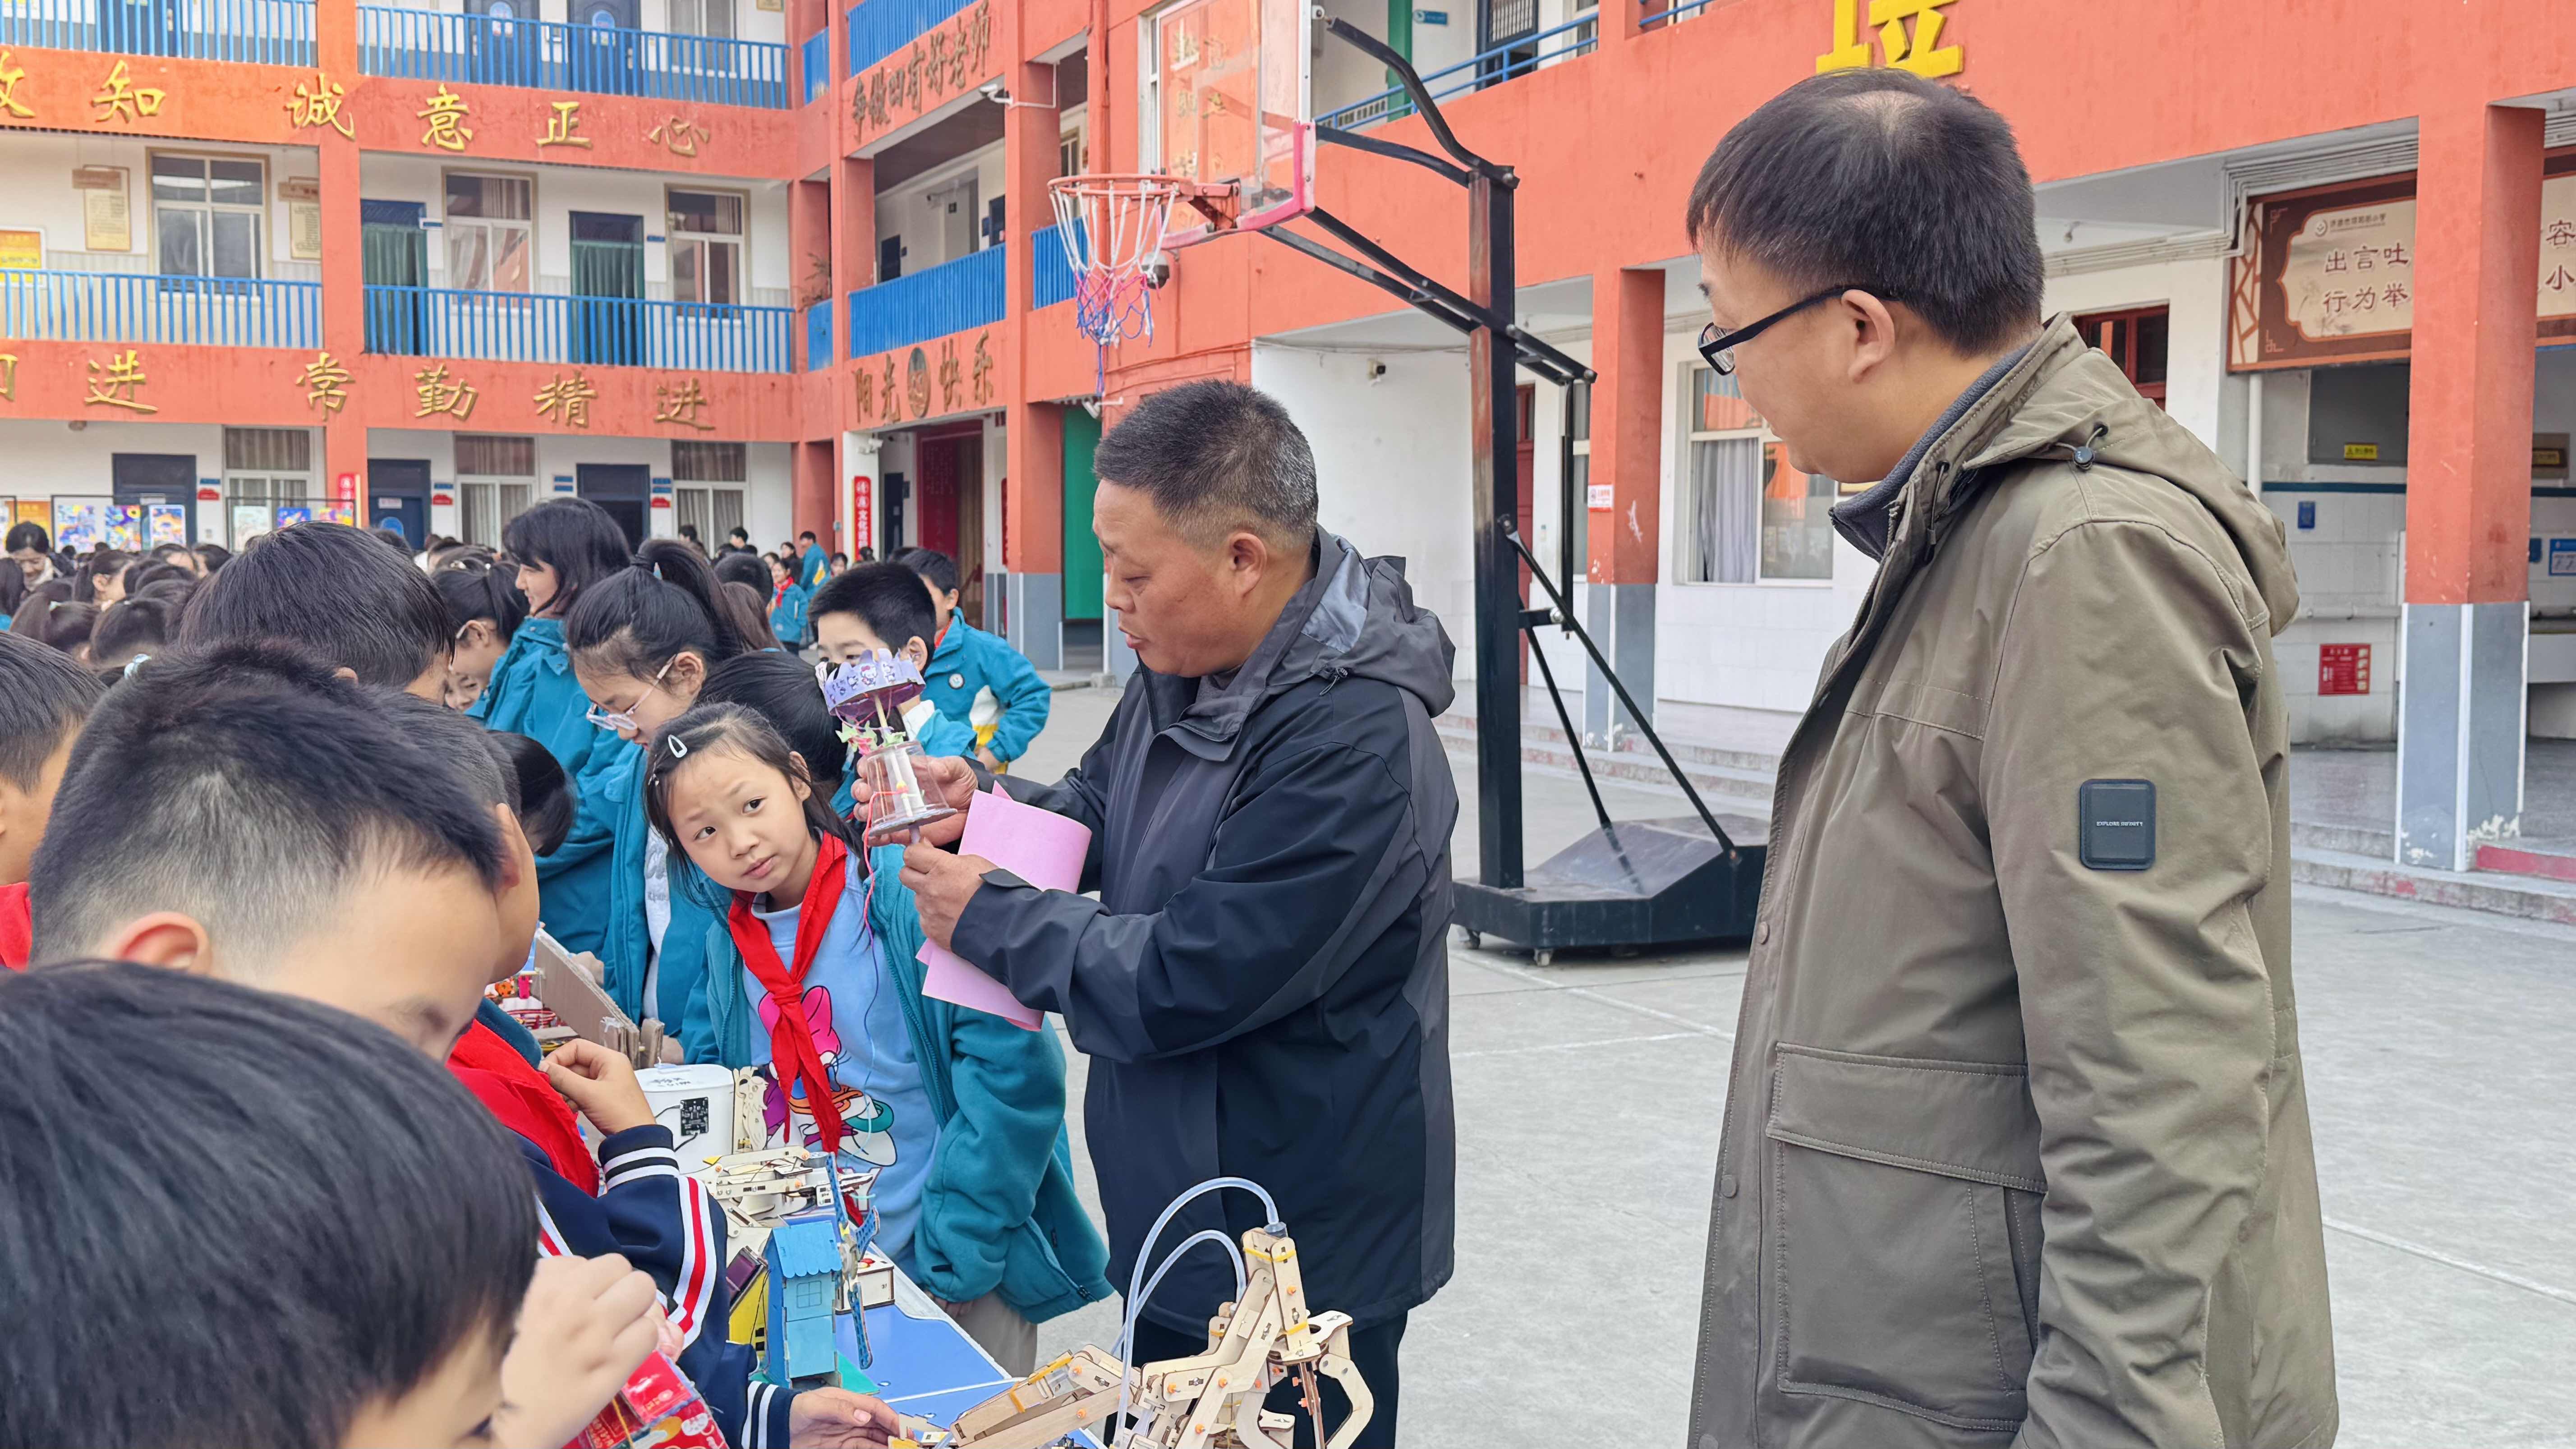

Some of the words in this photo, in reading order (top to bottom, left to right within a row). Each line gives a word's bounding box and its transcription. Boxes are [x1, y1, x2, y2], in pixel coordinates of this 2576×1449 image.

[2325, 242, 2409, 272] 出言吐
[2546, 219, 2576, 245] 容
[2323, 283, 2408, 313] 行为举
